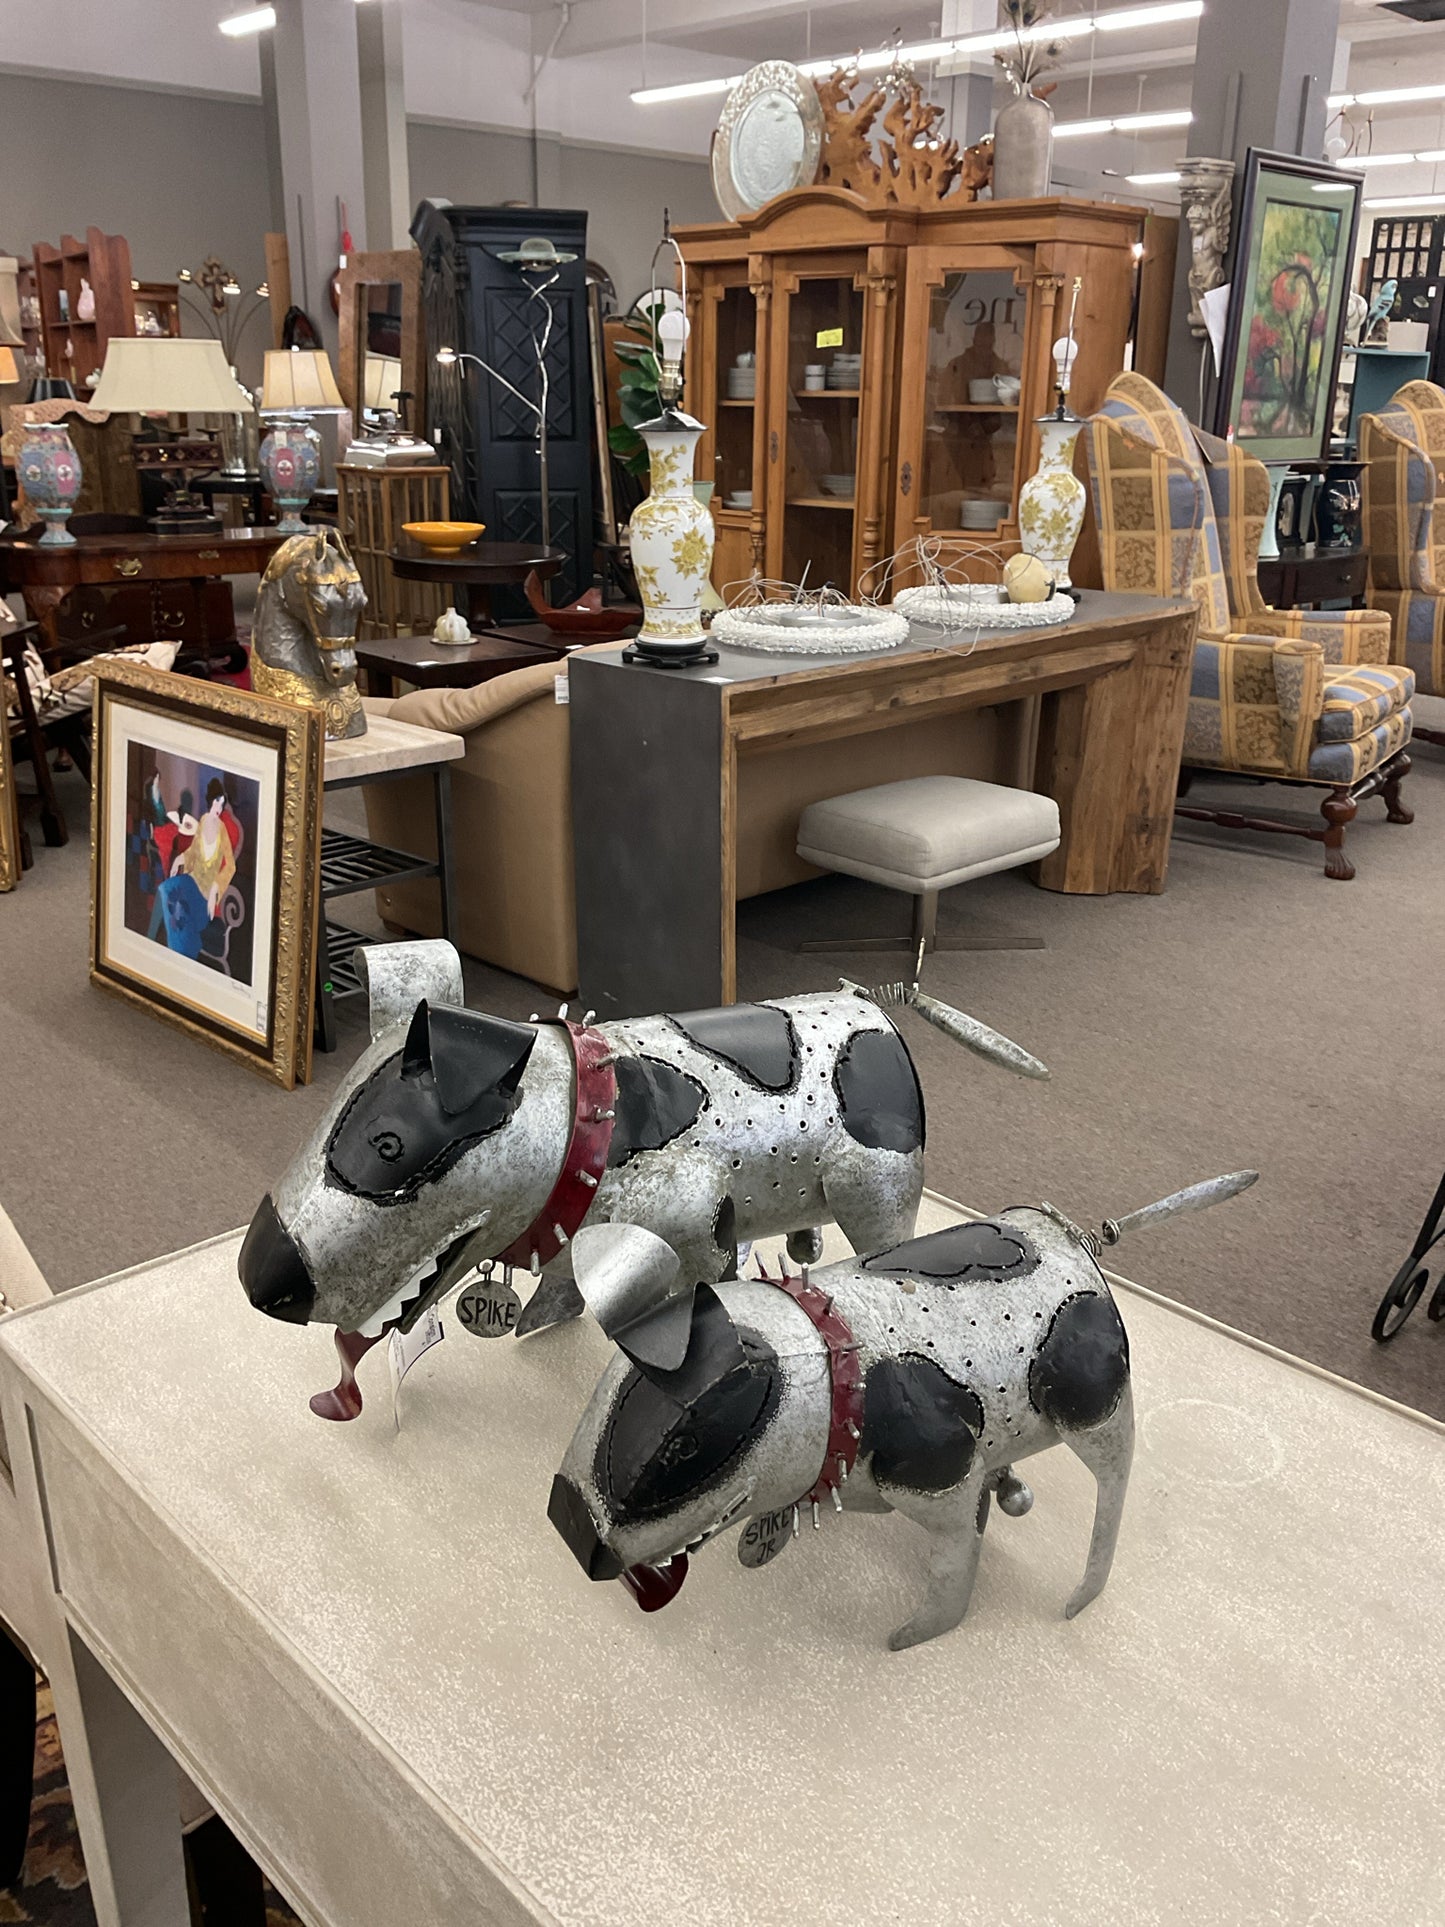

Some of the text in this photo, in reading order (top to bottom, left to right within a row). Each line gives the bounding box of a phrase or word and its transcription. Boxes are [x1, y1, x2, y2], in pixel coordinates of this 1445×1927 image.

[460, 1296, 516, 1327] SPIKE
[745, 1506, 790, 1545] SPIKE
[757, 1538, 776, 1564] JR
